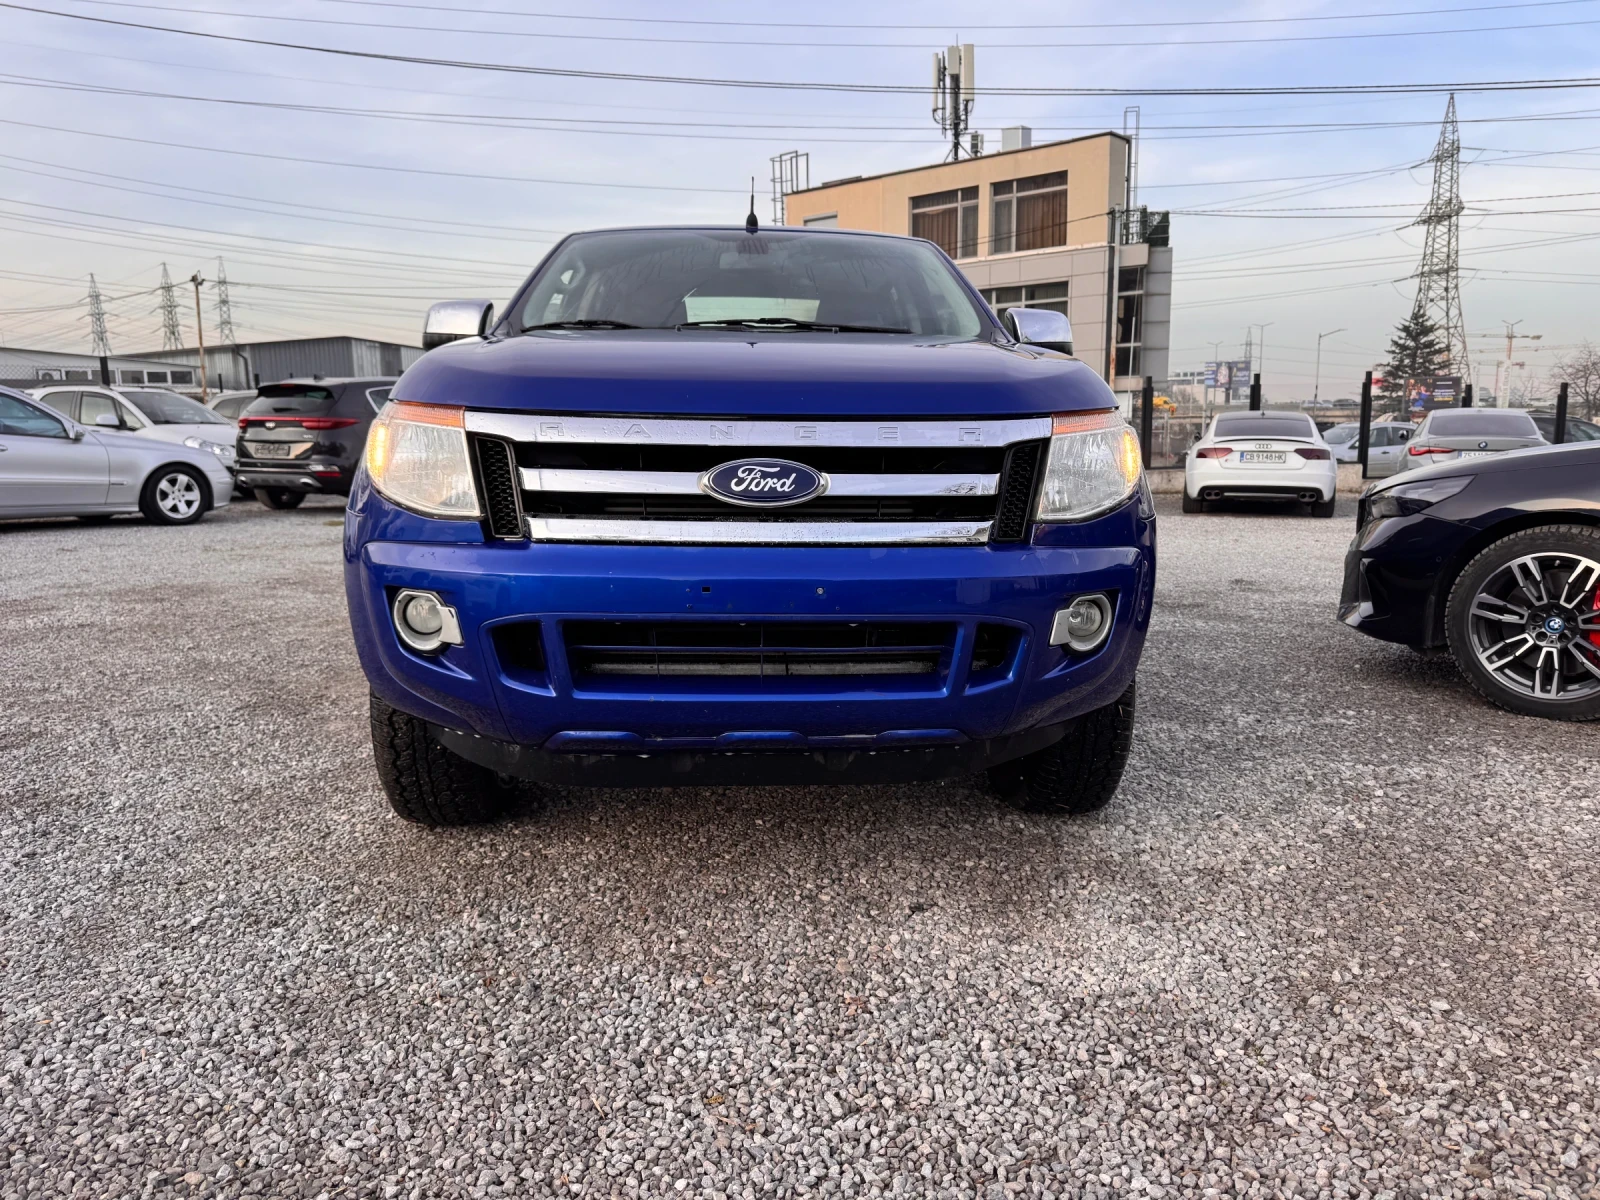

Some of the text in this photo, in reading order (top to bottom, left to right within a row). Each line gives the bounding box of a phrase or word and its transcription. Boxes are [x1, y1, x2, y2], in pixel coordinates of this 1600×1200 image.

[540, 421, 981, 442] RANGER
[1245, 453, 1254, 461] CB
[730, 465, 797, 492] Ford
